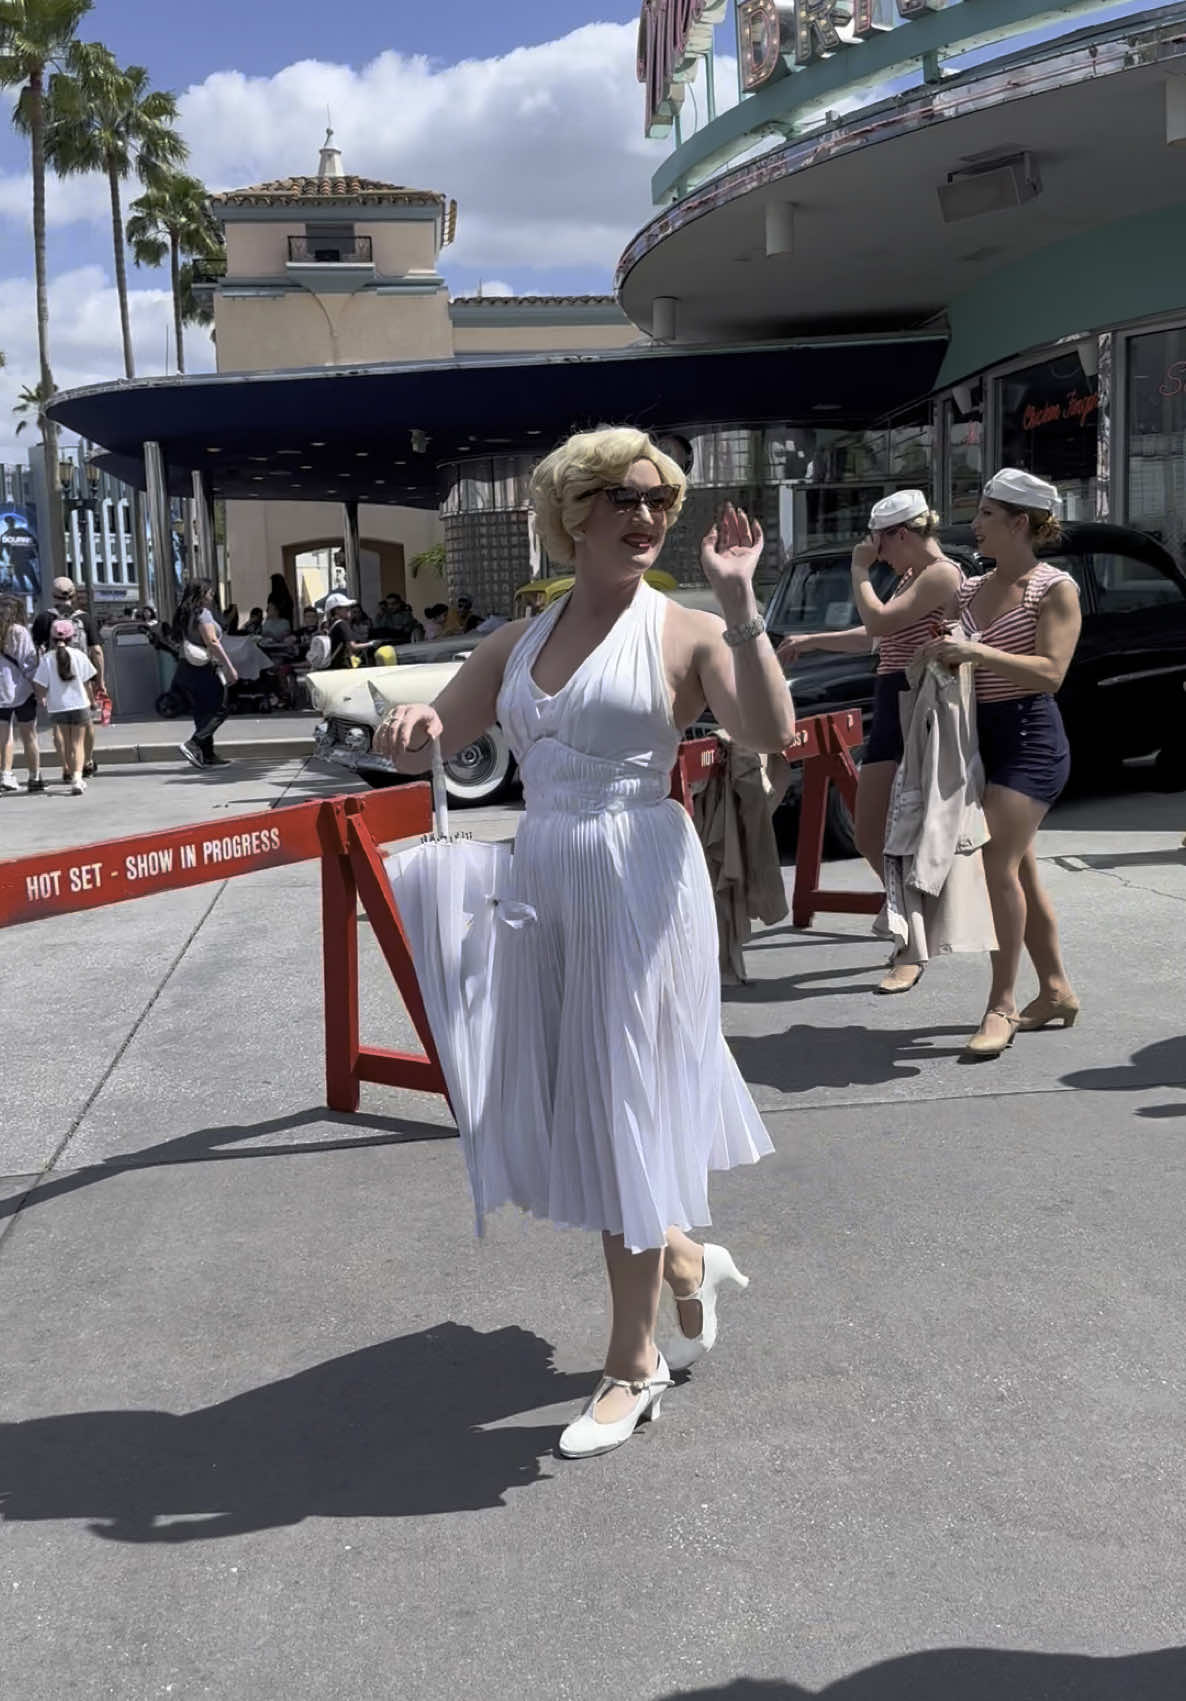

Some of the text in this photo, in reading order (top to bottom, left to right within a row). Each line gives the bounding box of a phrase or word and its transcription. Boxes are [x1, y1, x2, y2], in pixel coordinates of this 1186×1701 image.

[26, 871, 61, 900] HOT
[70, 862, 103, 892] SET
[125, 848, 173, 879] SHOW
[180, 844, 196, 869] IN
[203, 828, 281, 865] PROGRESS
